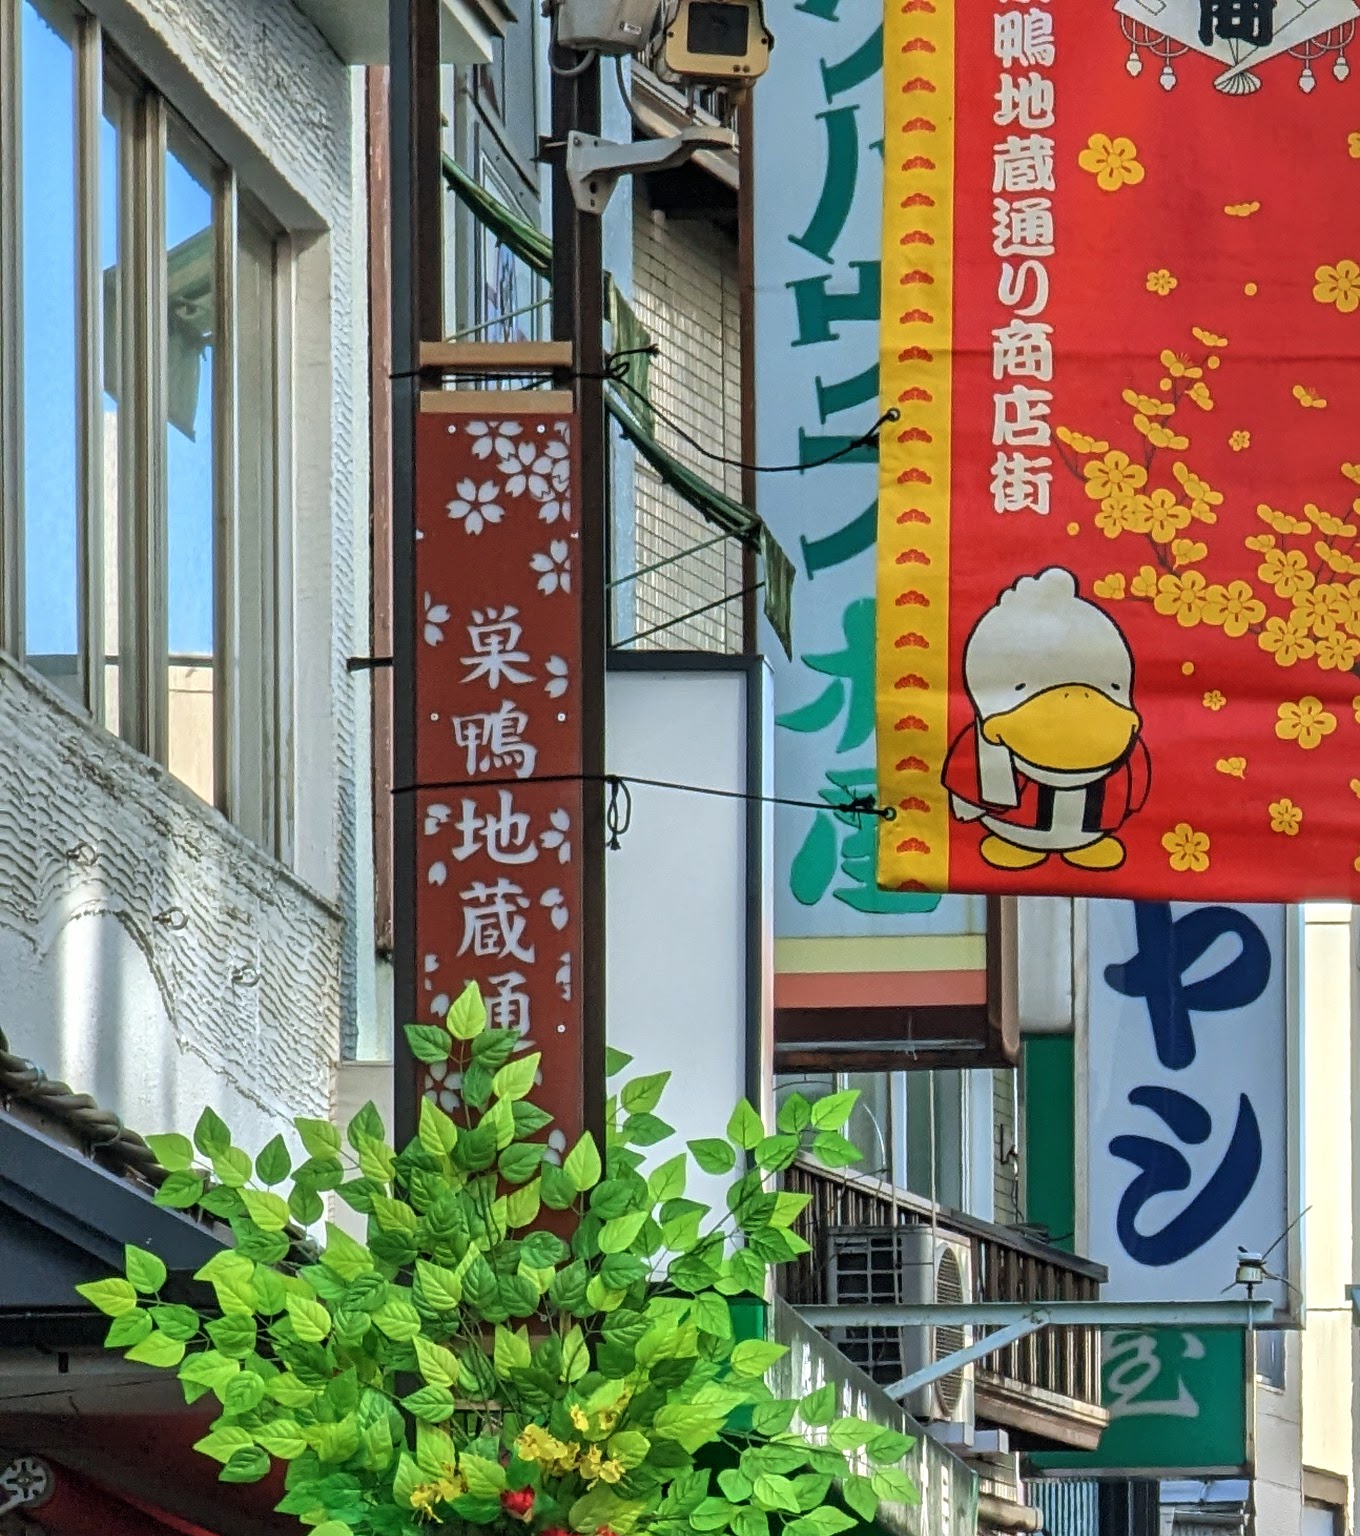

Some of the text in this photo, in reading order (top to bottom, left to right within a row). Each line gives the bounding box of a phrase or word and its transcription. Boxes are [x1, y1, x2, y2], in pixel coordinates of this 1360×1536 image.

[989, 0, 1057, 516] 鴨地蔵通り商店街
